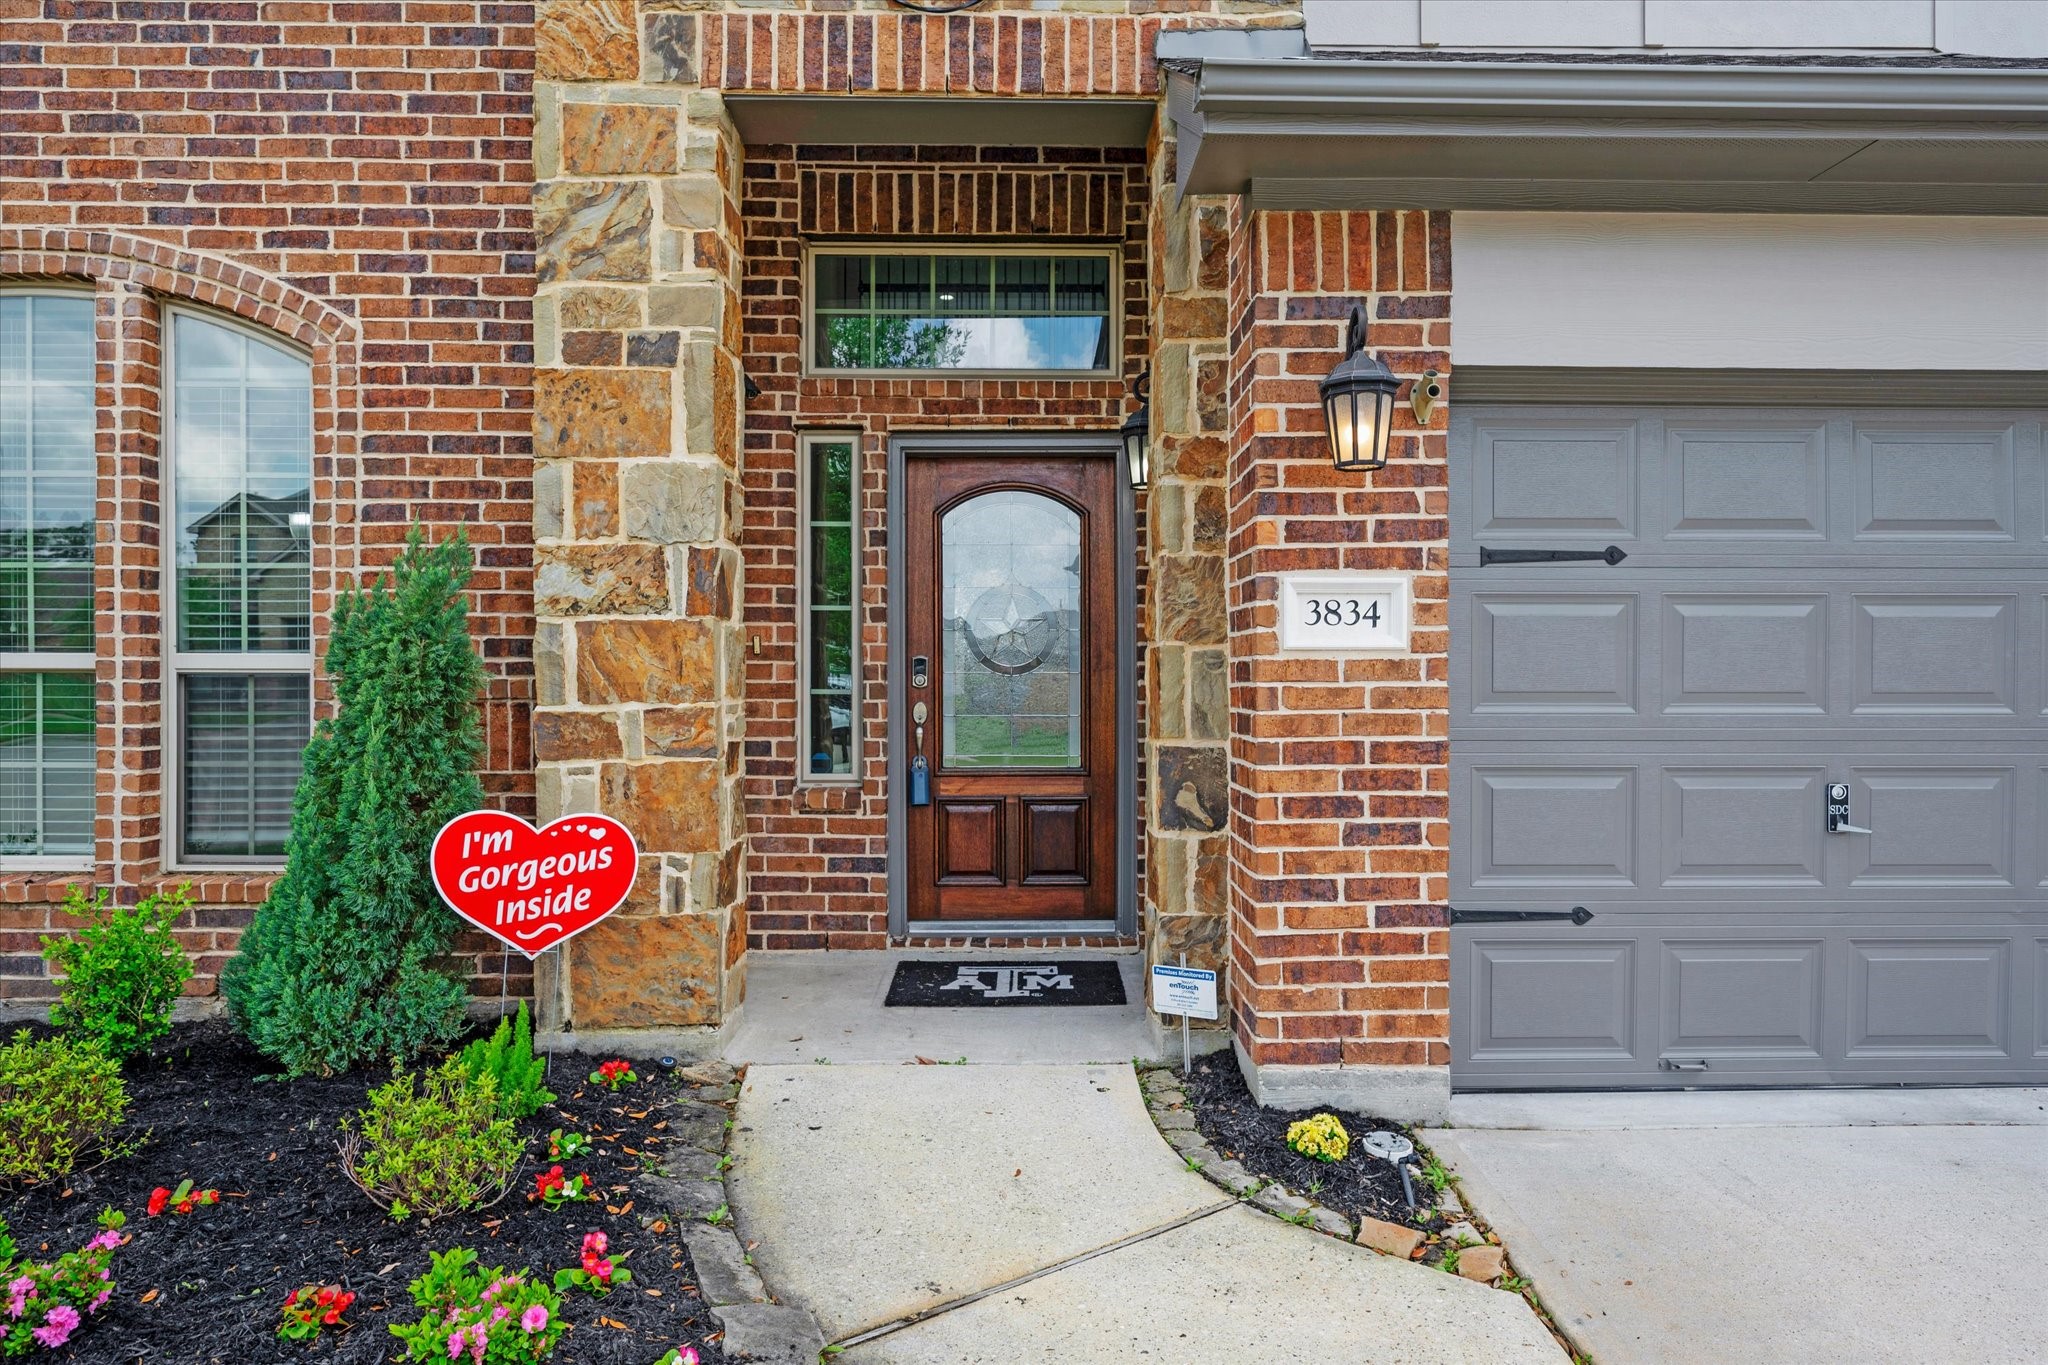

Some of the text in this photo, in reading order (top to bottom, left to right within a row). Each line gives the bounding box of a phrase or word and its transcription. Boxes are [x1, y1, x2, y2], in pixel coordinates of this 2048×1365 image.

[1304, 599, 1381, 628] 3834
[1829, 805, 1849, 815] SDC
[462, 829, 513, 859] I'm
[458, 846, 613, 893] Gorgeous
[495, 884, 592, 926] Inside
[1155, 967, 1177, 975] Premises
[1178, 970, 1204, 979] Monitored
[1169, 982, 1199, 991] enTouch
